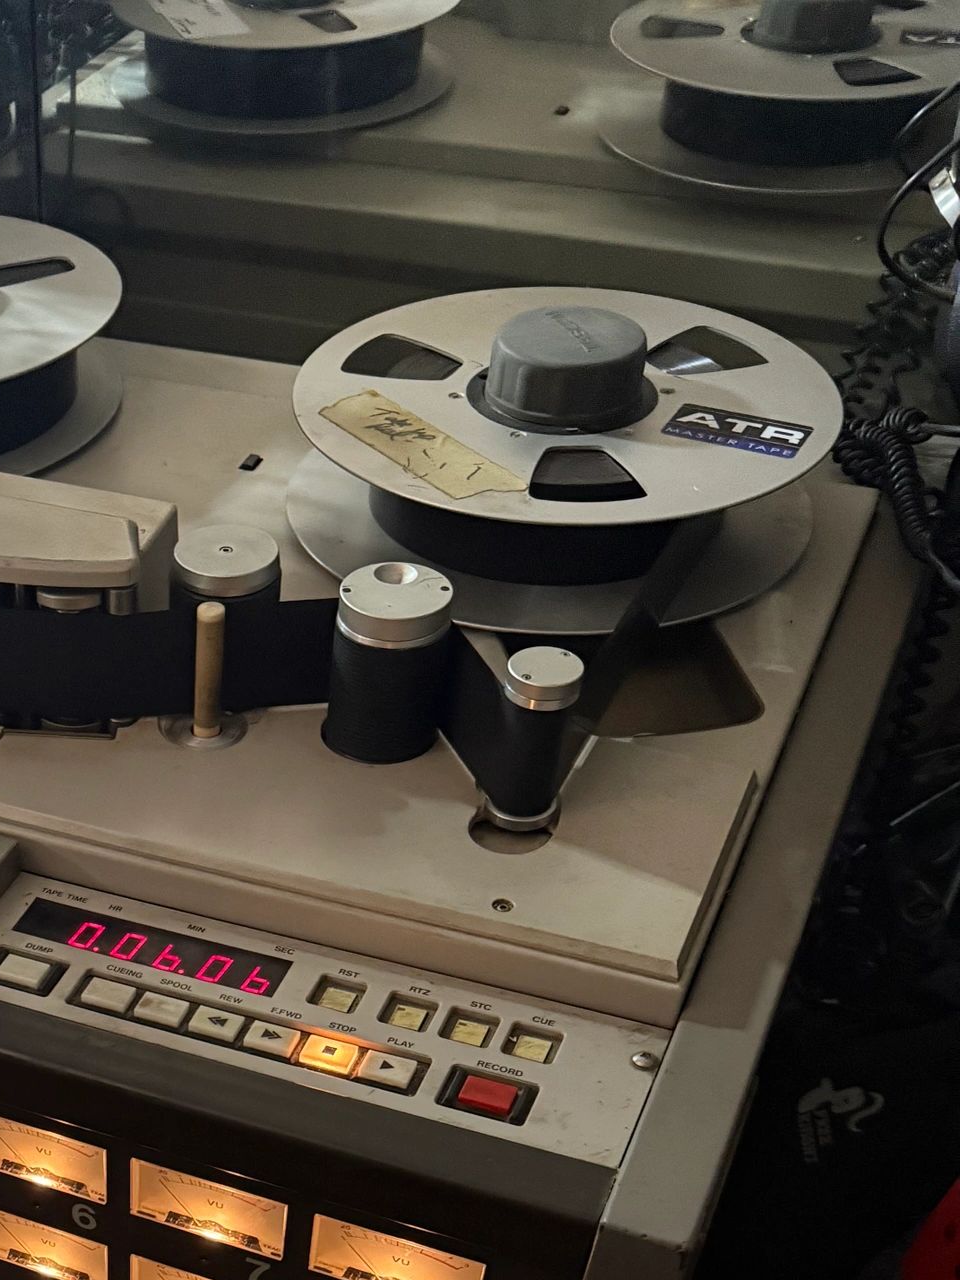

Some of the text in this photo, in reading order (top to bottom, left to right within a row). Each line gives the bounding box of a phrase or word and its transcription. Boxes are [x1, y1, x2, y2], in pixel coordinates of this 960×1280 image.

[676, 412, 805, 445] ATR
[665, 426, 793, 457] MASTER TAPE
[42, 887, 88, 904] TAPE TIME
[108, 904, 123, 912] HR
[186, 923, 206, 933] MIN
[25, 942, 54, 954] DUMP
[273, 945, 296, 955] SEC
[106, 964, 144, 979] CUEING
[338, 968, 360, 979] RST
[159, 978, 193, 992] SPOOL
[408, 985, 431, 996] RTZ
[219, 993, 244, 1005] REW
[470, 1000, 493, 1011] STC
[270, 1006, 302, 1020] F.FWD
[328, 1021, 357, 1034] STOP
[532, 1015, 556, 1028] CUE
[387, 1036, 415, 1049] PLAY
[476, 1059, 524, 1078] RECORD
[35, 1145, 52, 1157] VU
[207, 1198, 224, 1209] VU
[71, 1202, 97, 1231] 6
[40, 1237, 56, 1248] VU
[392, 1256, 410, 1266] VU
